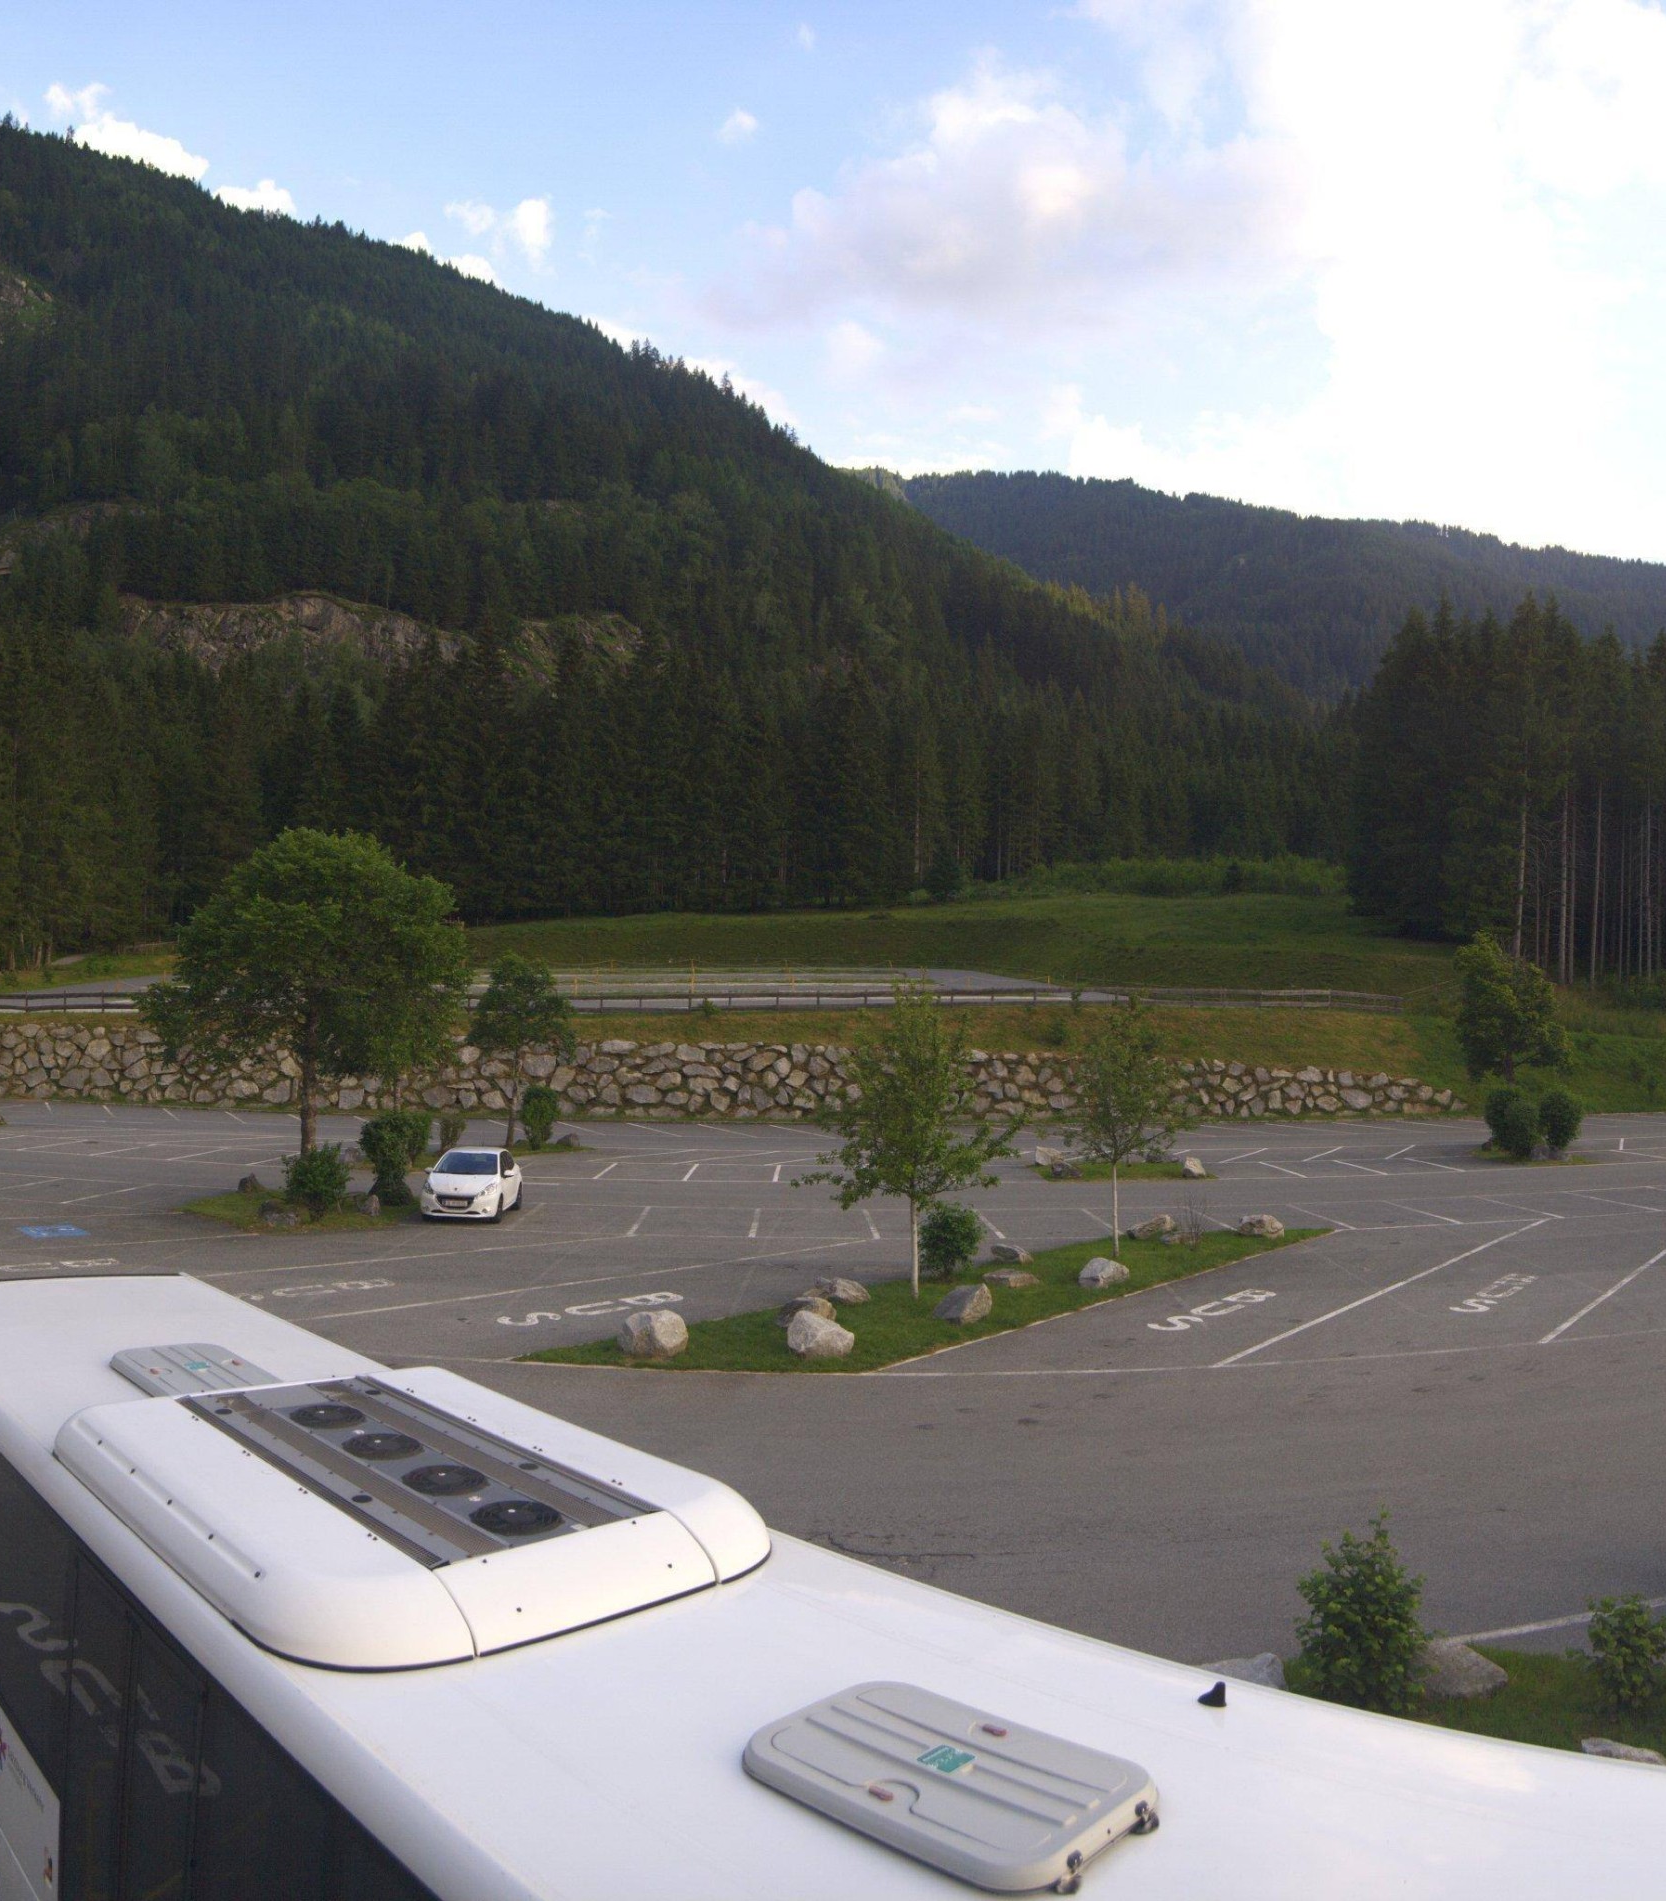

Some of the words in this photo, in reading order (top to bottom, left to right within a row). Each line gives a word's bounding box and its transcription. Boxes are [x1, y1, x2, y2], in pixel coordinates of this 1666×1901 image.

[497, 1291, 684, 1326] BUS
[1147, 1289, 1277, 1331] BUS
[1449, 1273, 1539, 1312] BUS
